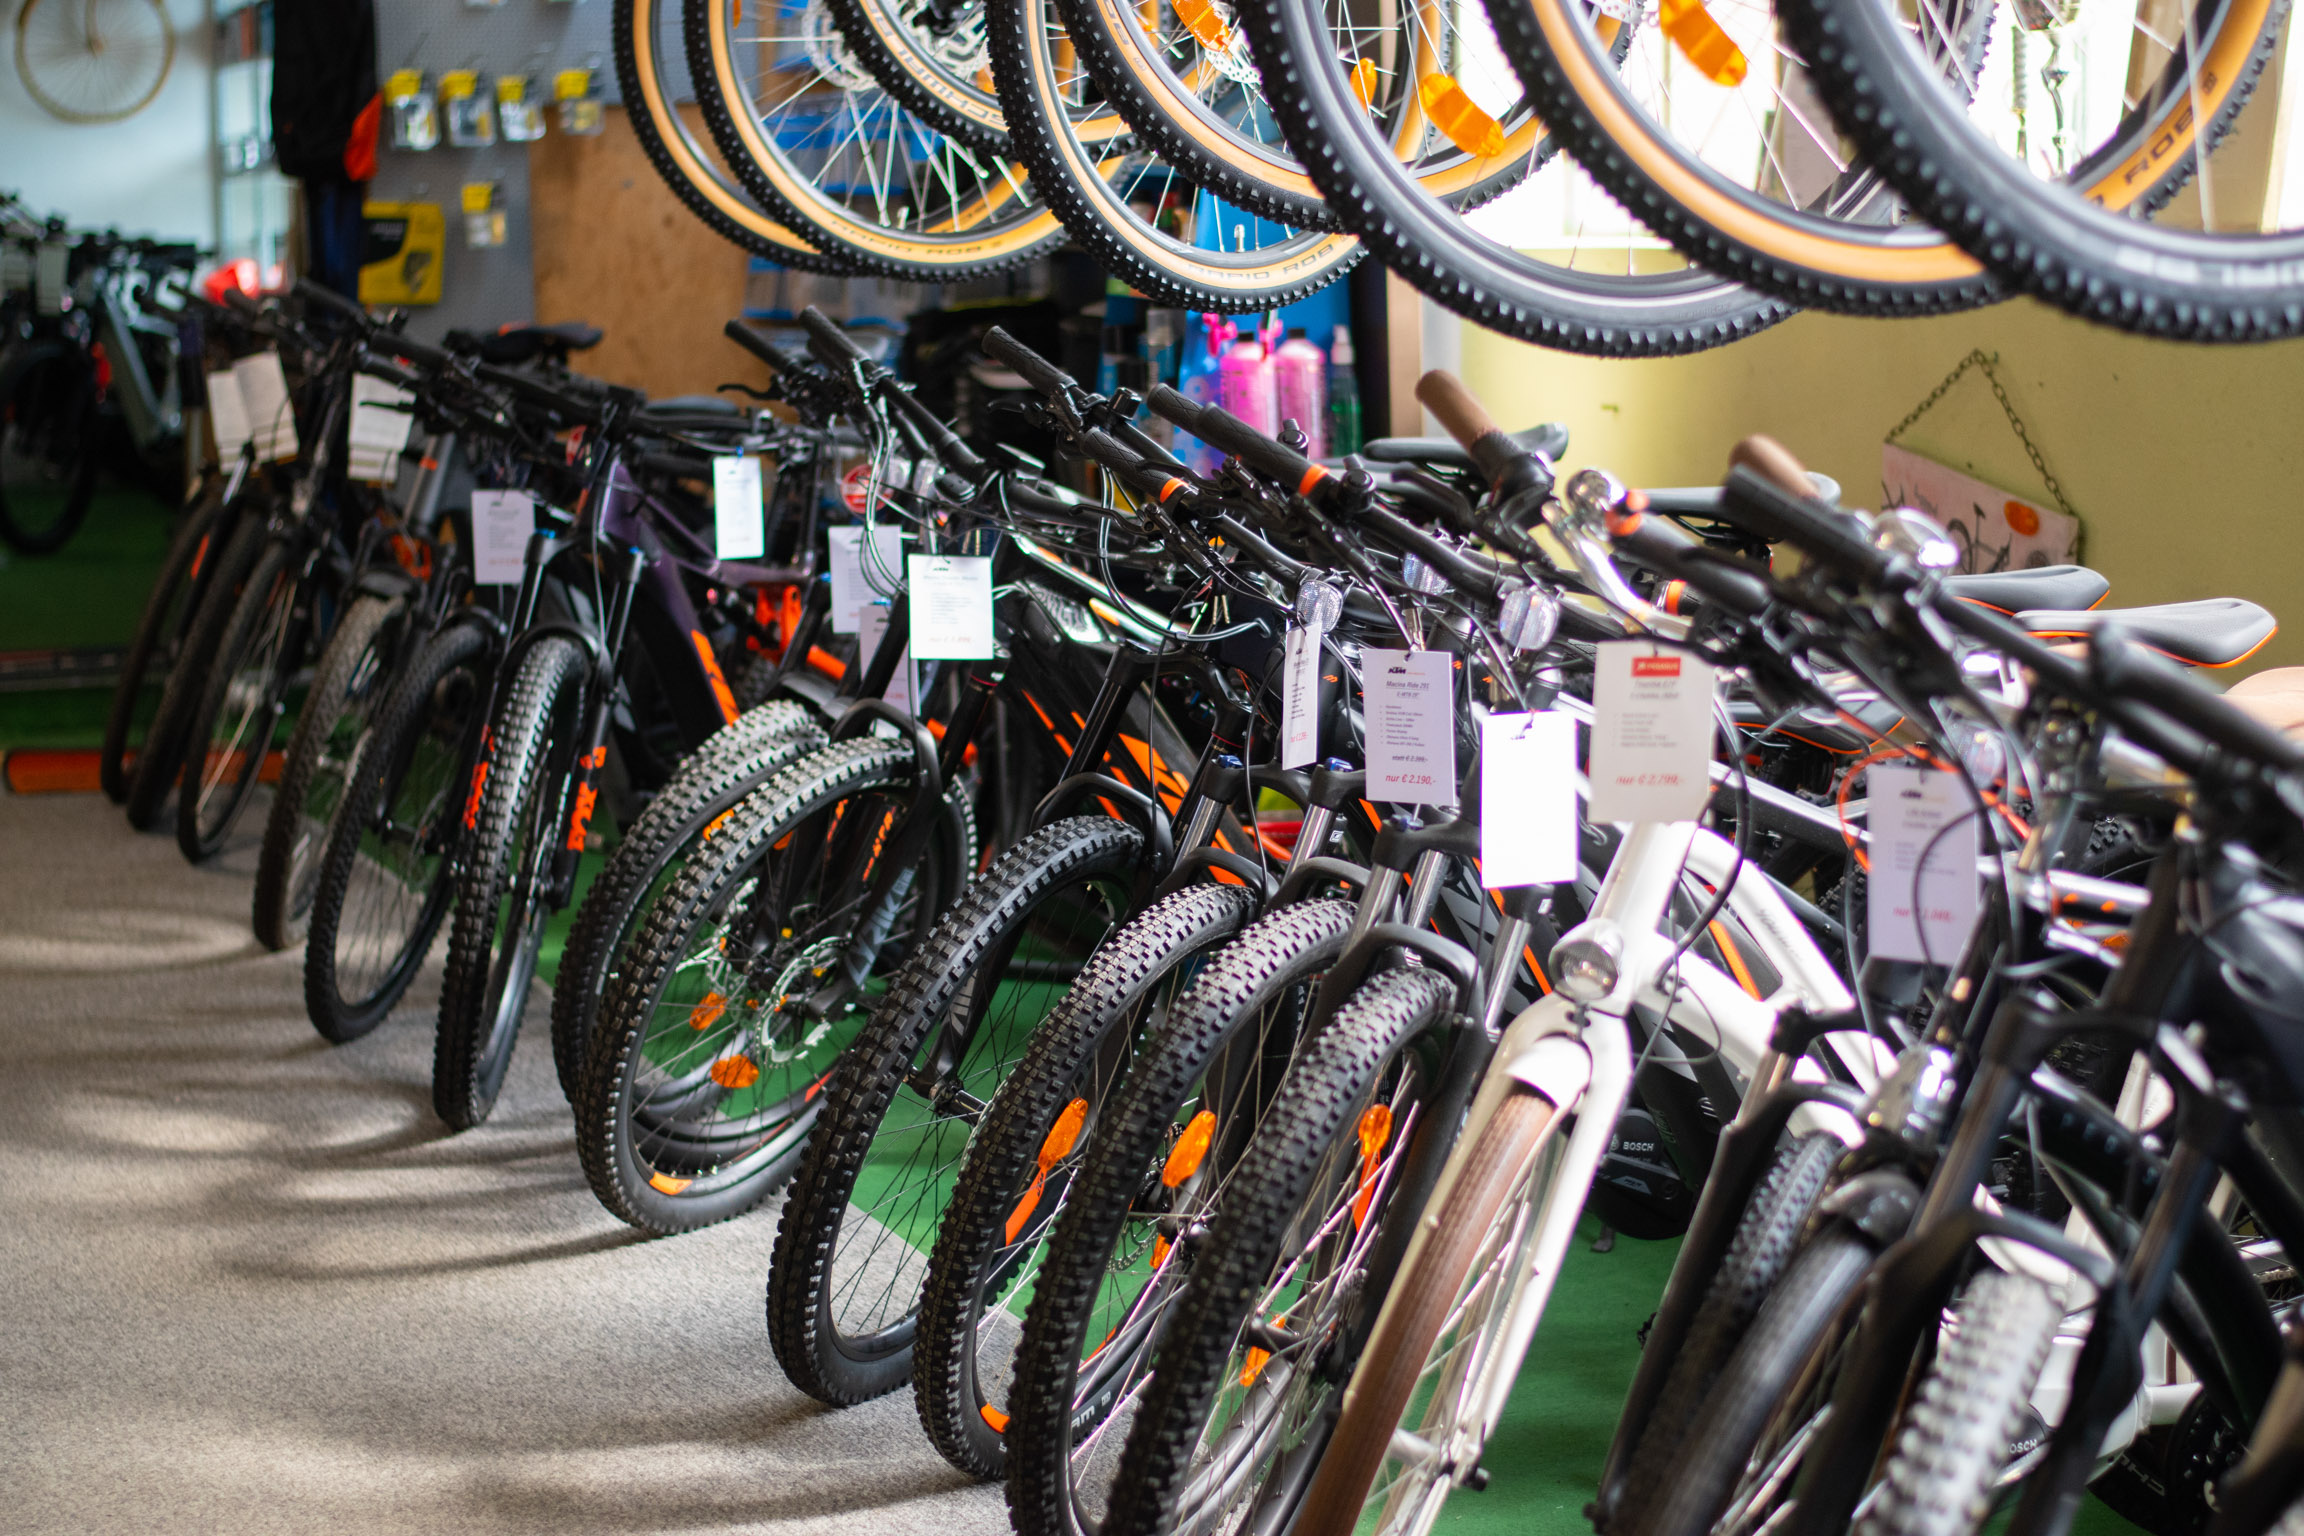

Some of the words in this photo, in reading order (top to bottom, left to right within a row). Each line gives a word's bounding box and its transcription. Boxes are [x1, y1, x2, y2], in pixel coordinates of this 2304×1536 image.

[1282, 243, 1335, 275] ROB
[1385, 774, 1400, 782] nur
[1401, 773, 1408, 783] €
[1408, 774, 1436, 786] 2.190,-
[1623, 1141, 1655, 1152] BOSCH
[2009, 1438, 2038, 1455] OSCH
